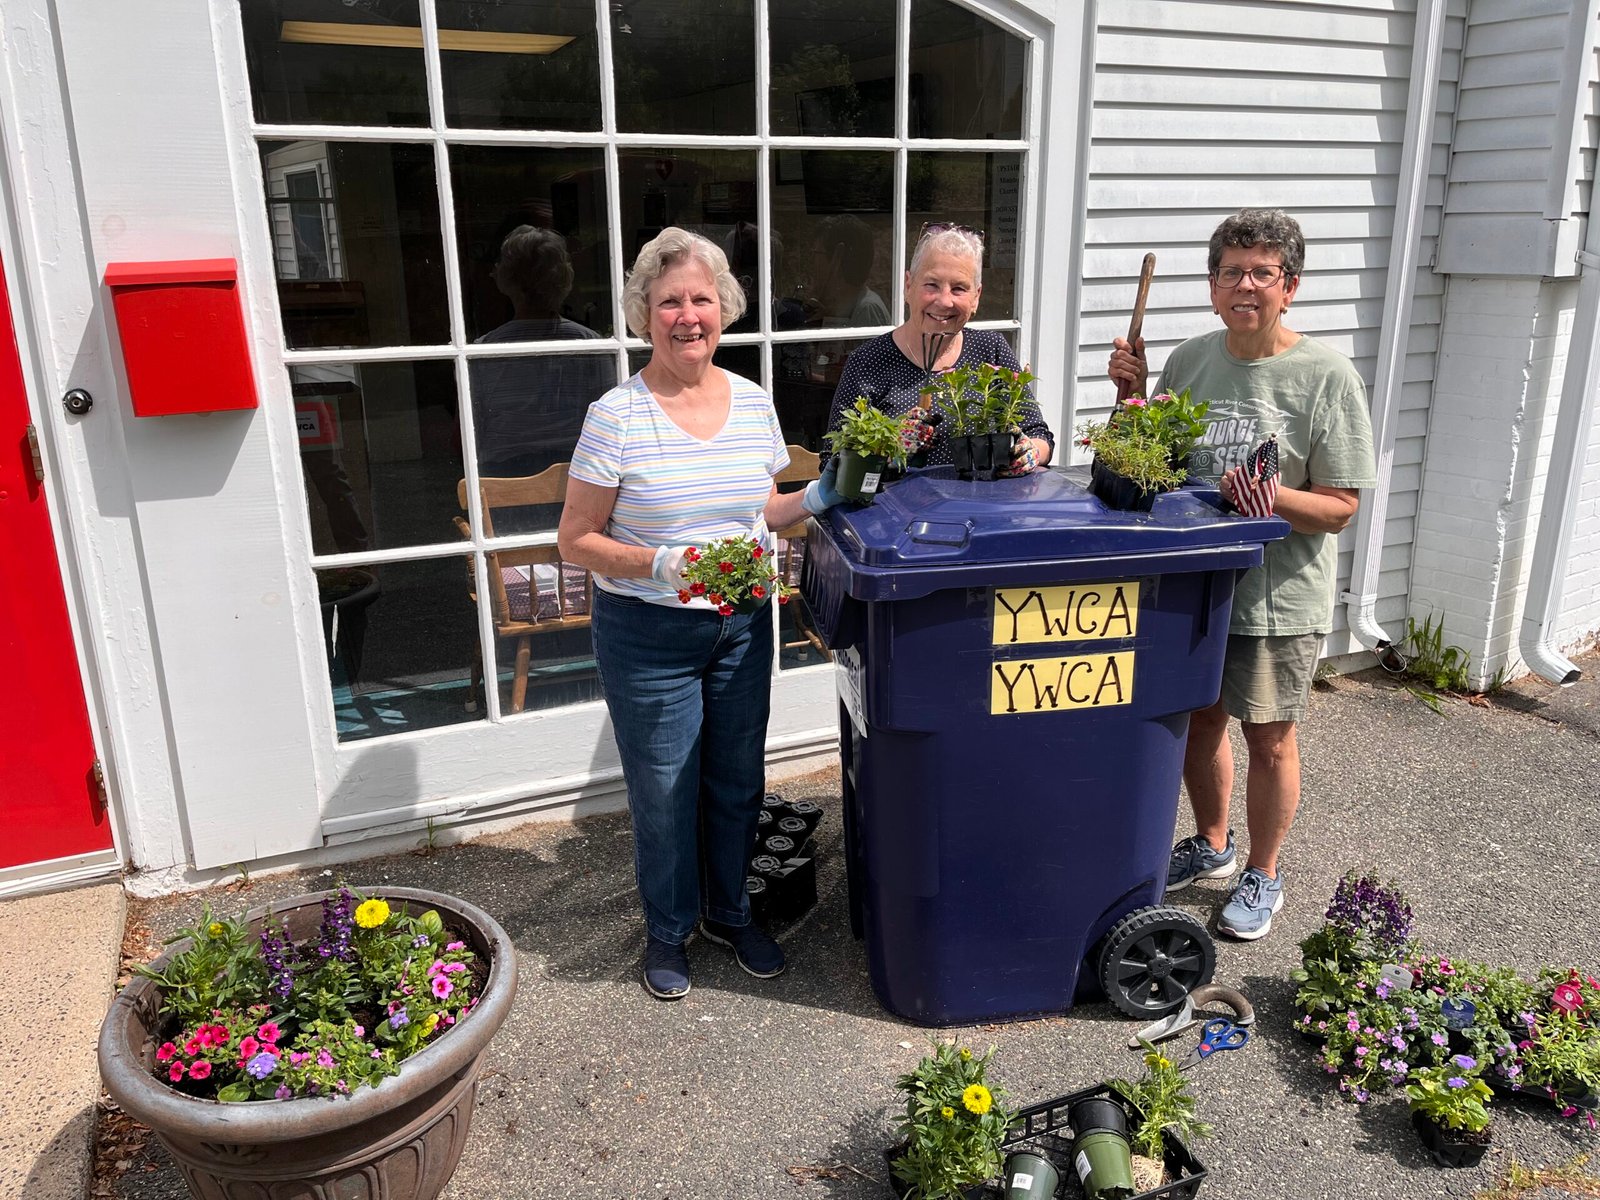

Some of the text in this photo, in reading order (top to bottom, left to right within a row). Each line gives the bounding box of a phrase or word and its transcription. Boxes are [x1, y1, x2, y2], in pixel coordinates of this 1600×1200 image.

[1194, 418, 1258, 446] OURCE
[1213, 444, 1249, 475] SEA
[995, 586, 1133, 642] YWCA
[994, 655, 1124, 713] YWCA
